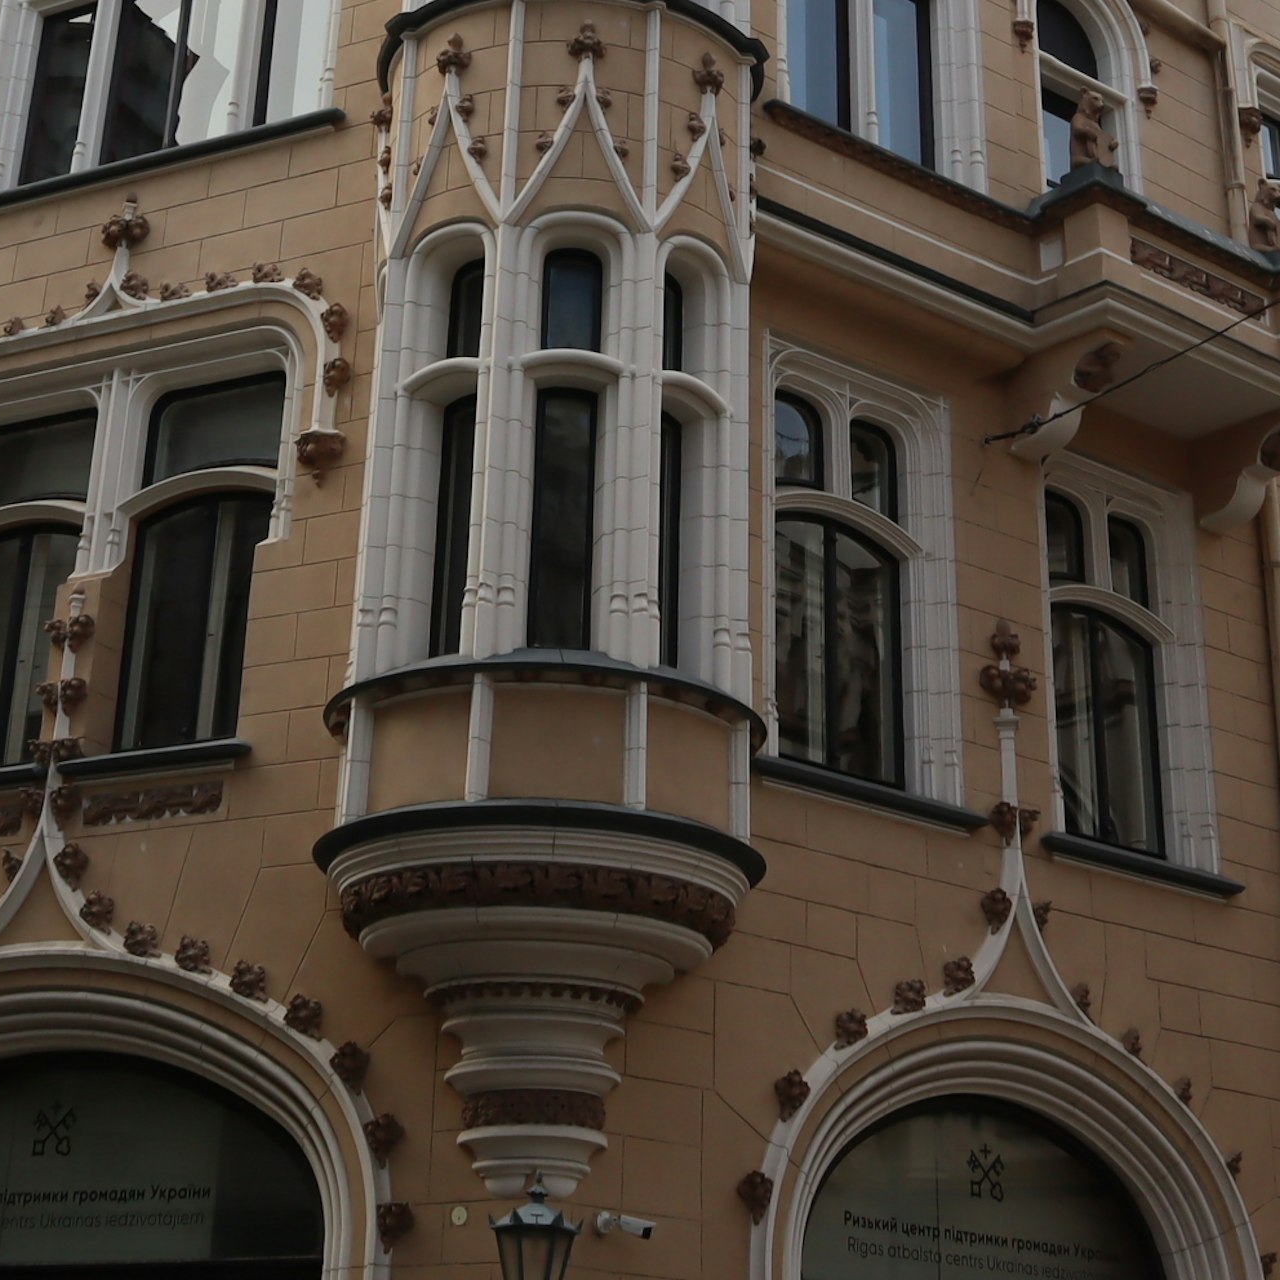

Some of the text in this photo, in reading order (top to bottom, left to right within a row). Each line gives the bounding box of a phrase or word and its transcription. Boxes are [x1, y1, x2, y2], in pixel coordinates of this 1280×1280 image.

[72, 1189, 145, 1205] громадян
[150, 1184, 211, 1204] України
[844, 1210, 897, 1232] Ризький
[902, 1222, 940, 1241] центр
[944, 1225, 1008, 1247] підтримки
[1012, 1237, 1070, 1256] громадян
[888, 1244, 942, 1264] atbalsta
[945, 1252, 984, 1269] centrs
[987, 1256, 1039, 1277] Ukrainas
